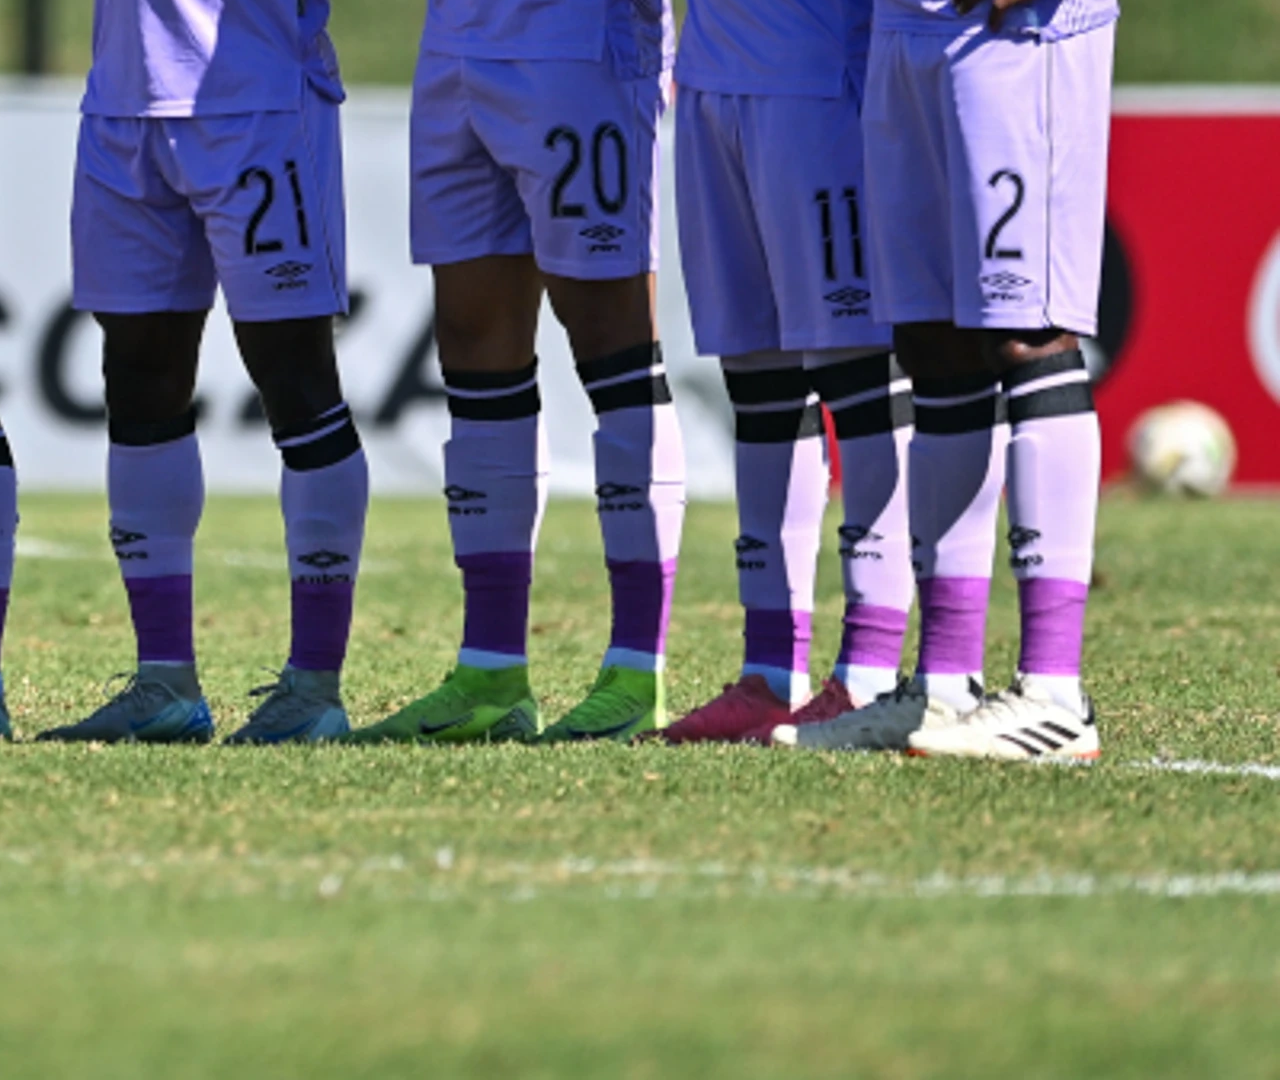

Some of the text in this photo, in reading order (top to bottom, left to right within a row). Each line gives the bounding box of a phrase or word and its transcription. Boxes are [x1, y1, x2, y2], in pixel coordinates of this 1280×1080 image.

[239, 160, 309, 255] 21
[544, 123, 628, 219] 20
[985, 169, 1025, 259] 2
[815, 187, 864, 282] 11
